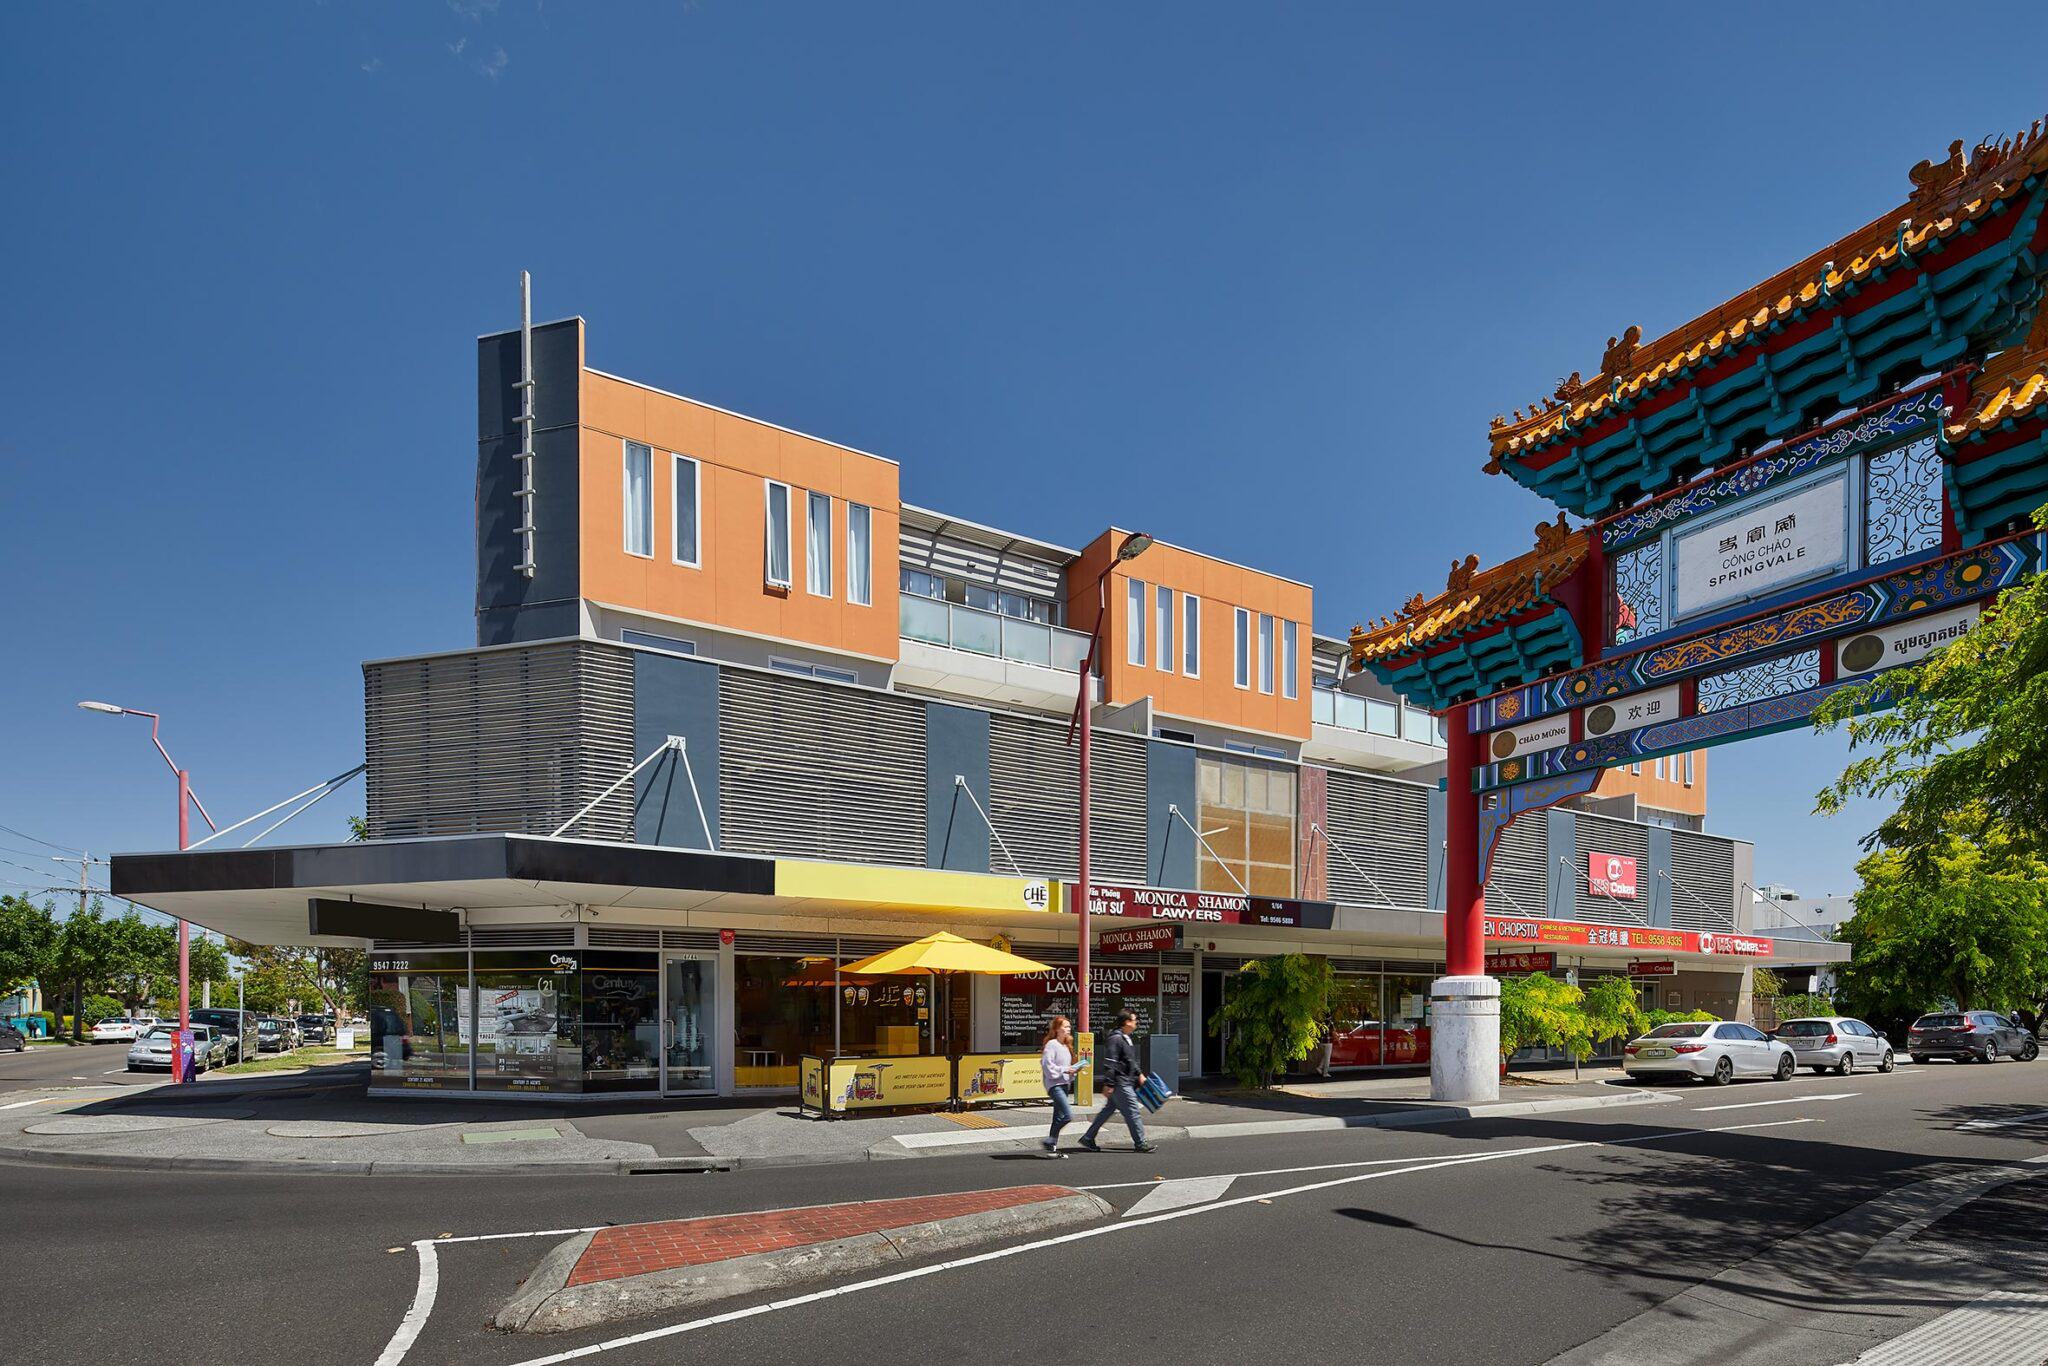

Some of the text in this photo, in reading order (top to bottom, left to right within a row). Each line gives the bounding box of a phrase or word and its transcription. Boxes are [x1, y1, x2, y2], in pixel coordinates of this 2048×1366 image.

[1709, 547, 1806, 587] SPRINGVALE
[1628, 700, 1661, 720] 欢迎
[1133, 890, 1251, 912] MONICA SHAMON
[1152, 906, 1222, 921] LAWYERS
[1102, 927, 1173, 944] MONICA SHAMON
[1498, 922, 1538, 938] CHOPSTIX
[1118, 941, 1154, 952] LAWYERS
[1631, 932, 1647, 944] TEL:
[1648, 934, 1665, 946] 9558
[373, 961, 409, 970] 9547 7222
[1089, 968, 1146, 982] SHAMON
